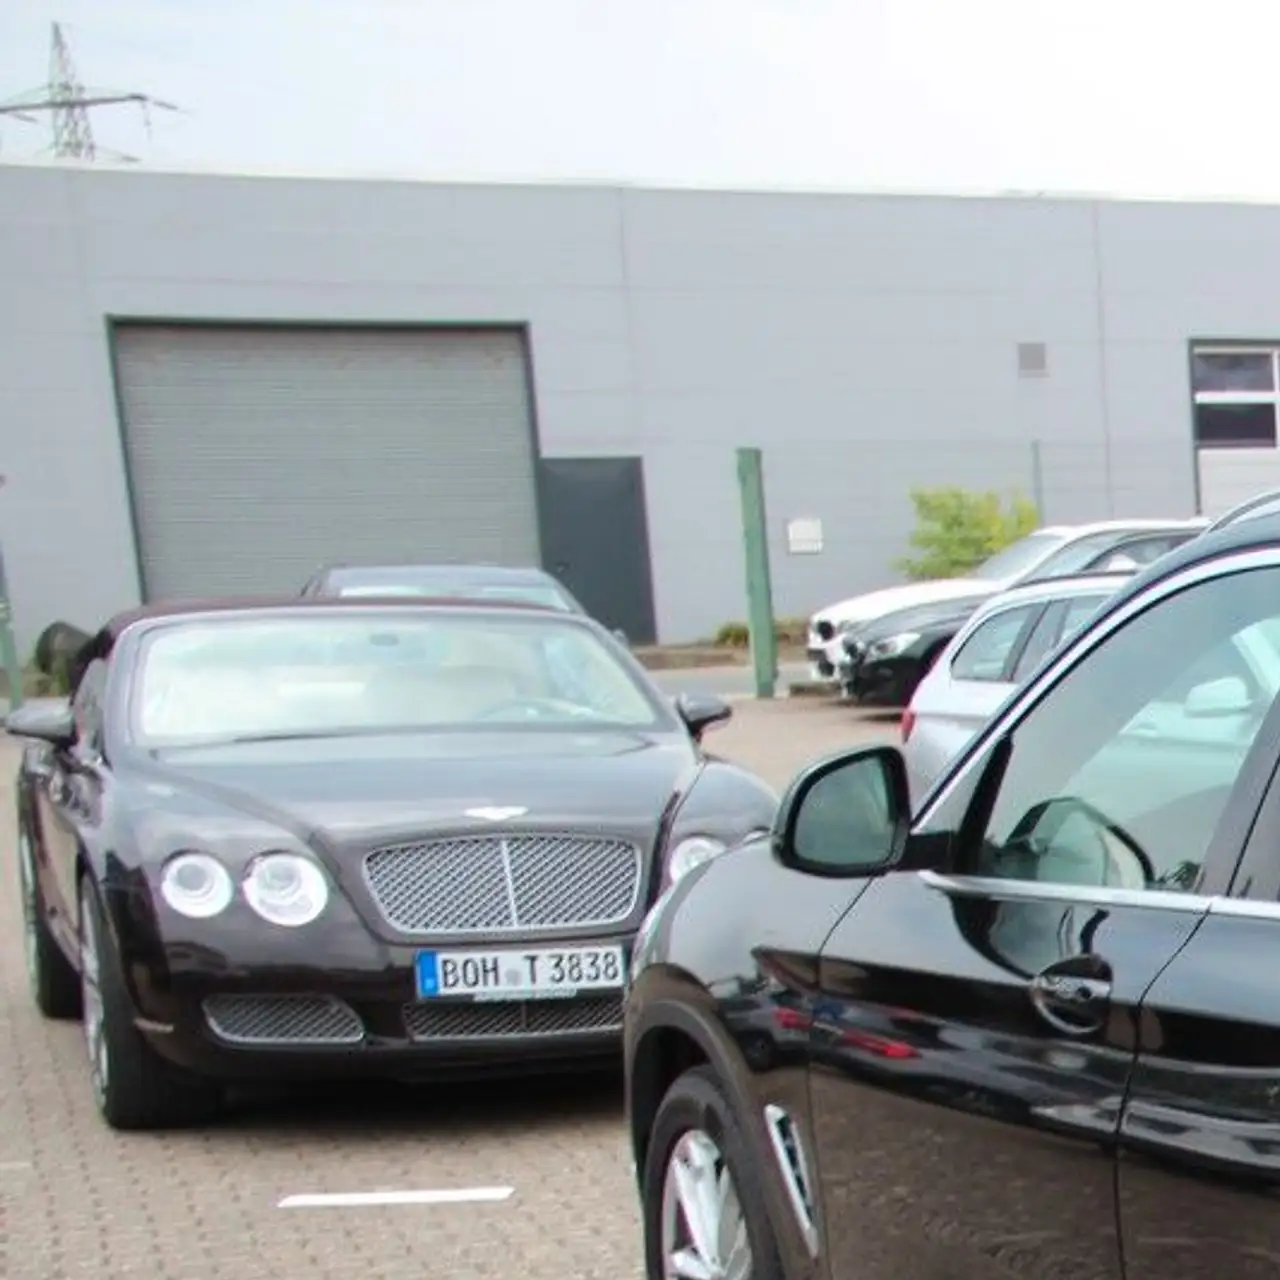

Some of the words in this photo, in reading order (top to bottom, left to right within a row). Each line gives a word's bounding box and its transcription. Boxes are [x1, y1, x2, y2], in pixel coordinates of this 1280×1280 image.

[441, 957, 498, 988] BOH
[523, 955, 540, 985] T
[550, 953, 620, 983] 3838
